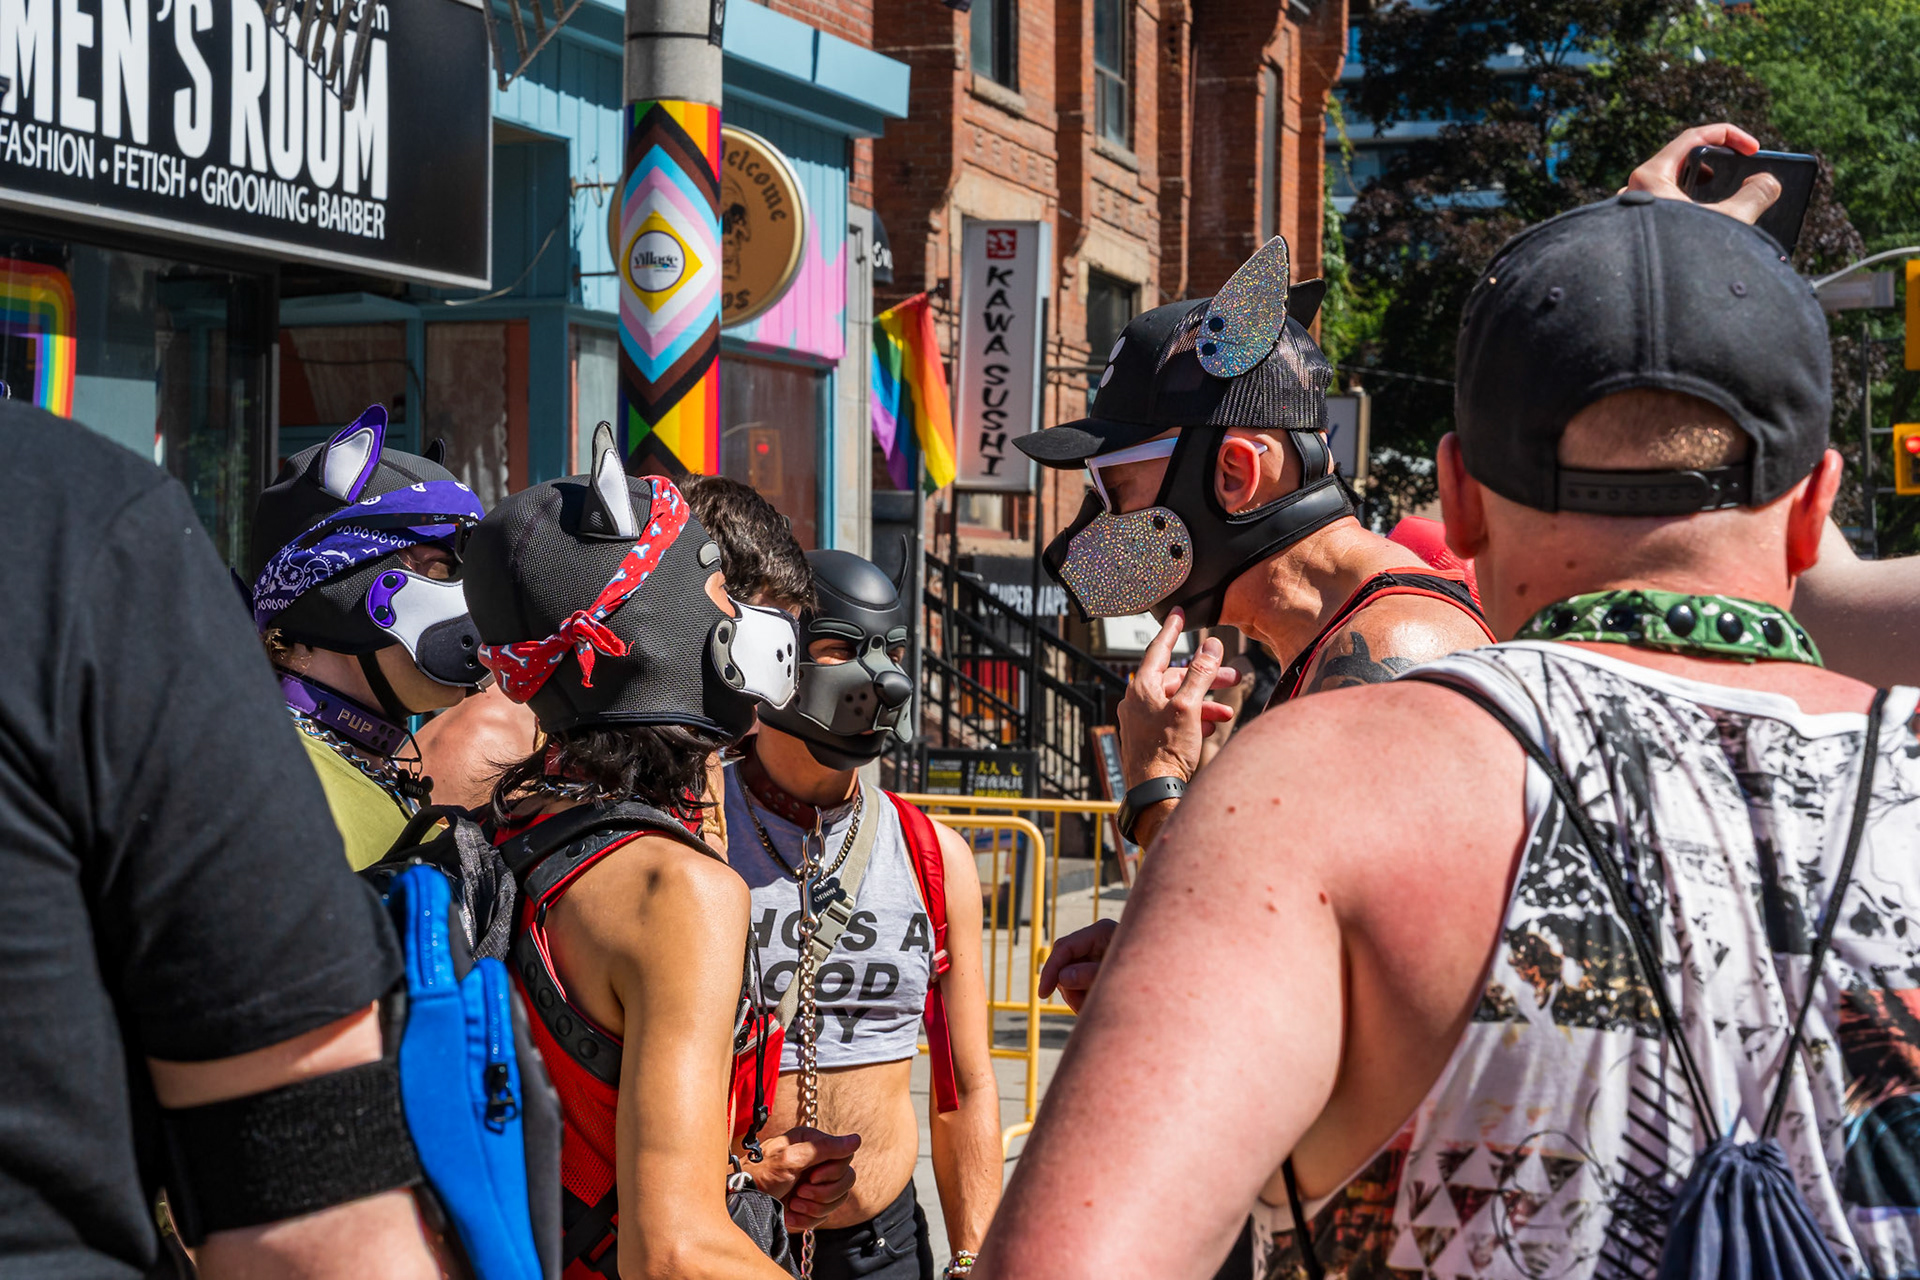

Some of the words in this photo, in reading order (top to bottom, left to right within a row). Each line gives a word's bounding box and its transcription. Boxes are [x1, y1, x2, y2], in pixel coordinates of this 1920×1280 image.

[0, 0, 214, 158] MEN'S
[229, 0, 389, 200] ROOM
[0, 117, 95, 180] FASHION
[113, 144, 187, 198] FETISH
[201, 165, 309, 225] GROOMING
[318, 191, 386, 240] BARBER
[721, 141, 787, 222] elcome
[983, 265, 1015, 356] KAWA
[979, 364, 1011, 477] SUSHI
[337, 708, 373, 733] PUP
[899, 912, 930, 953] A
[762, 960, 900, 1003] OOD
